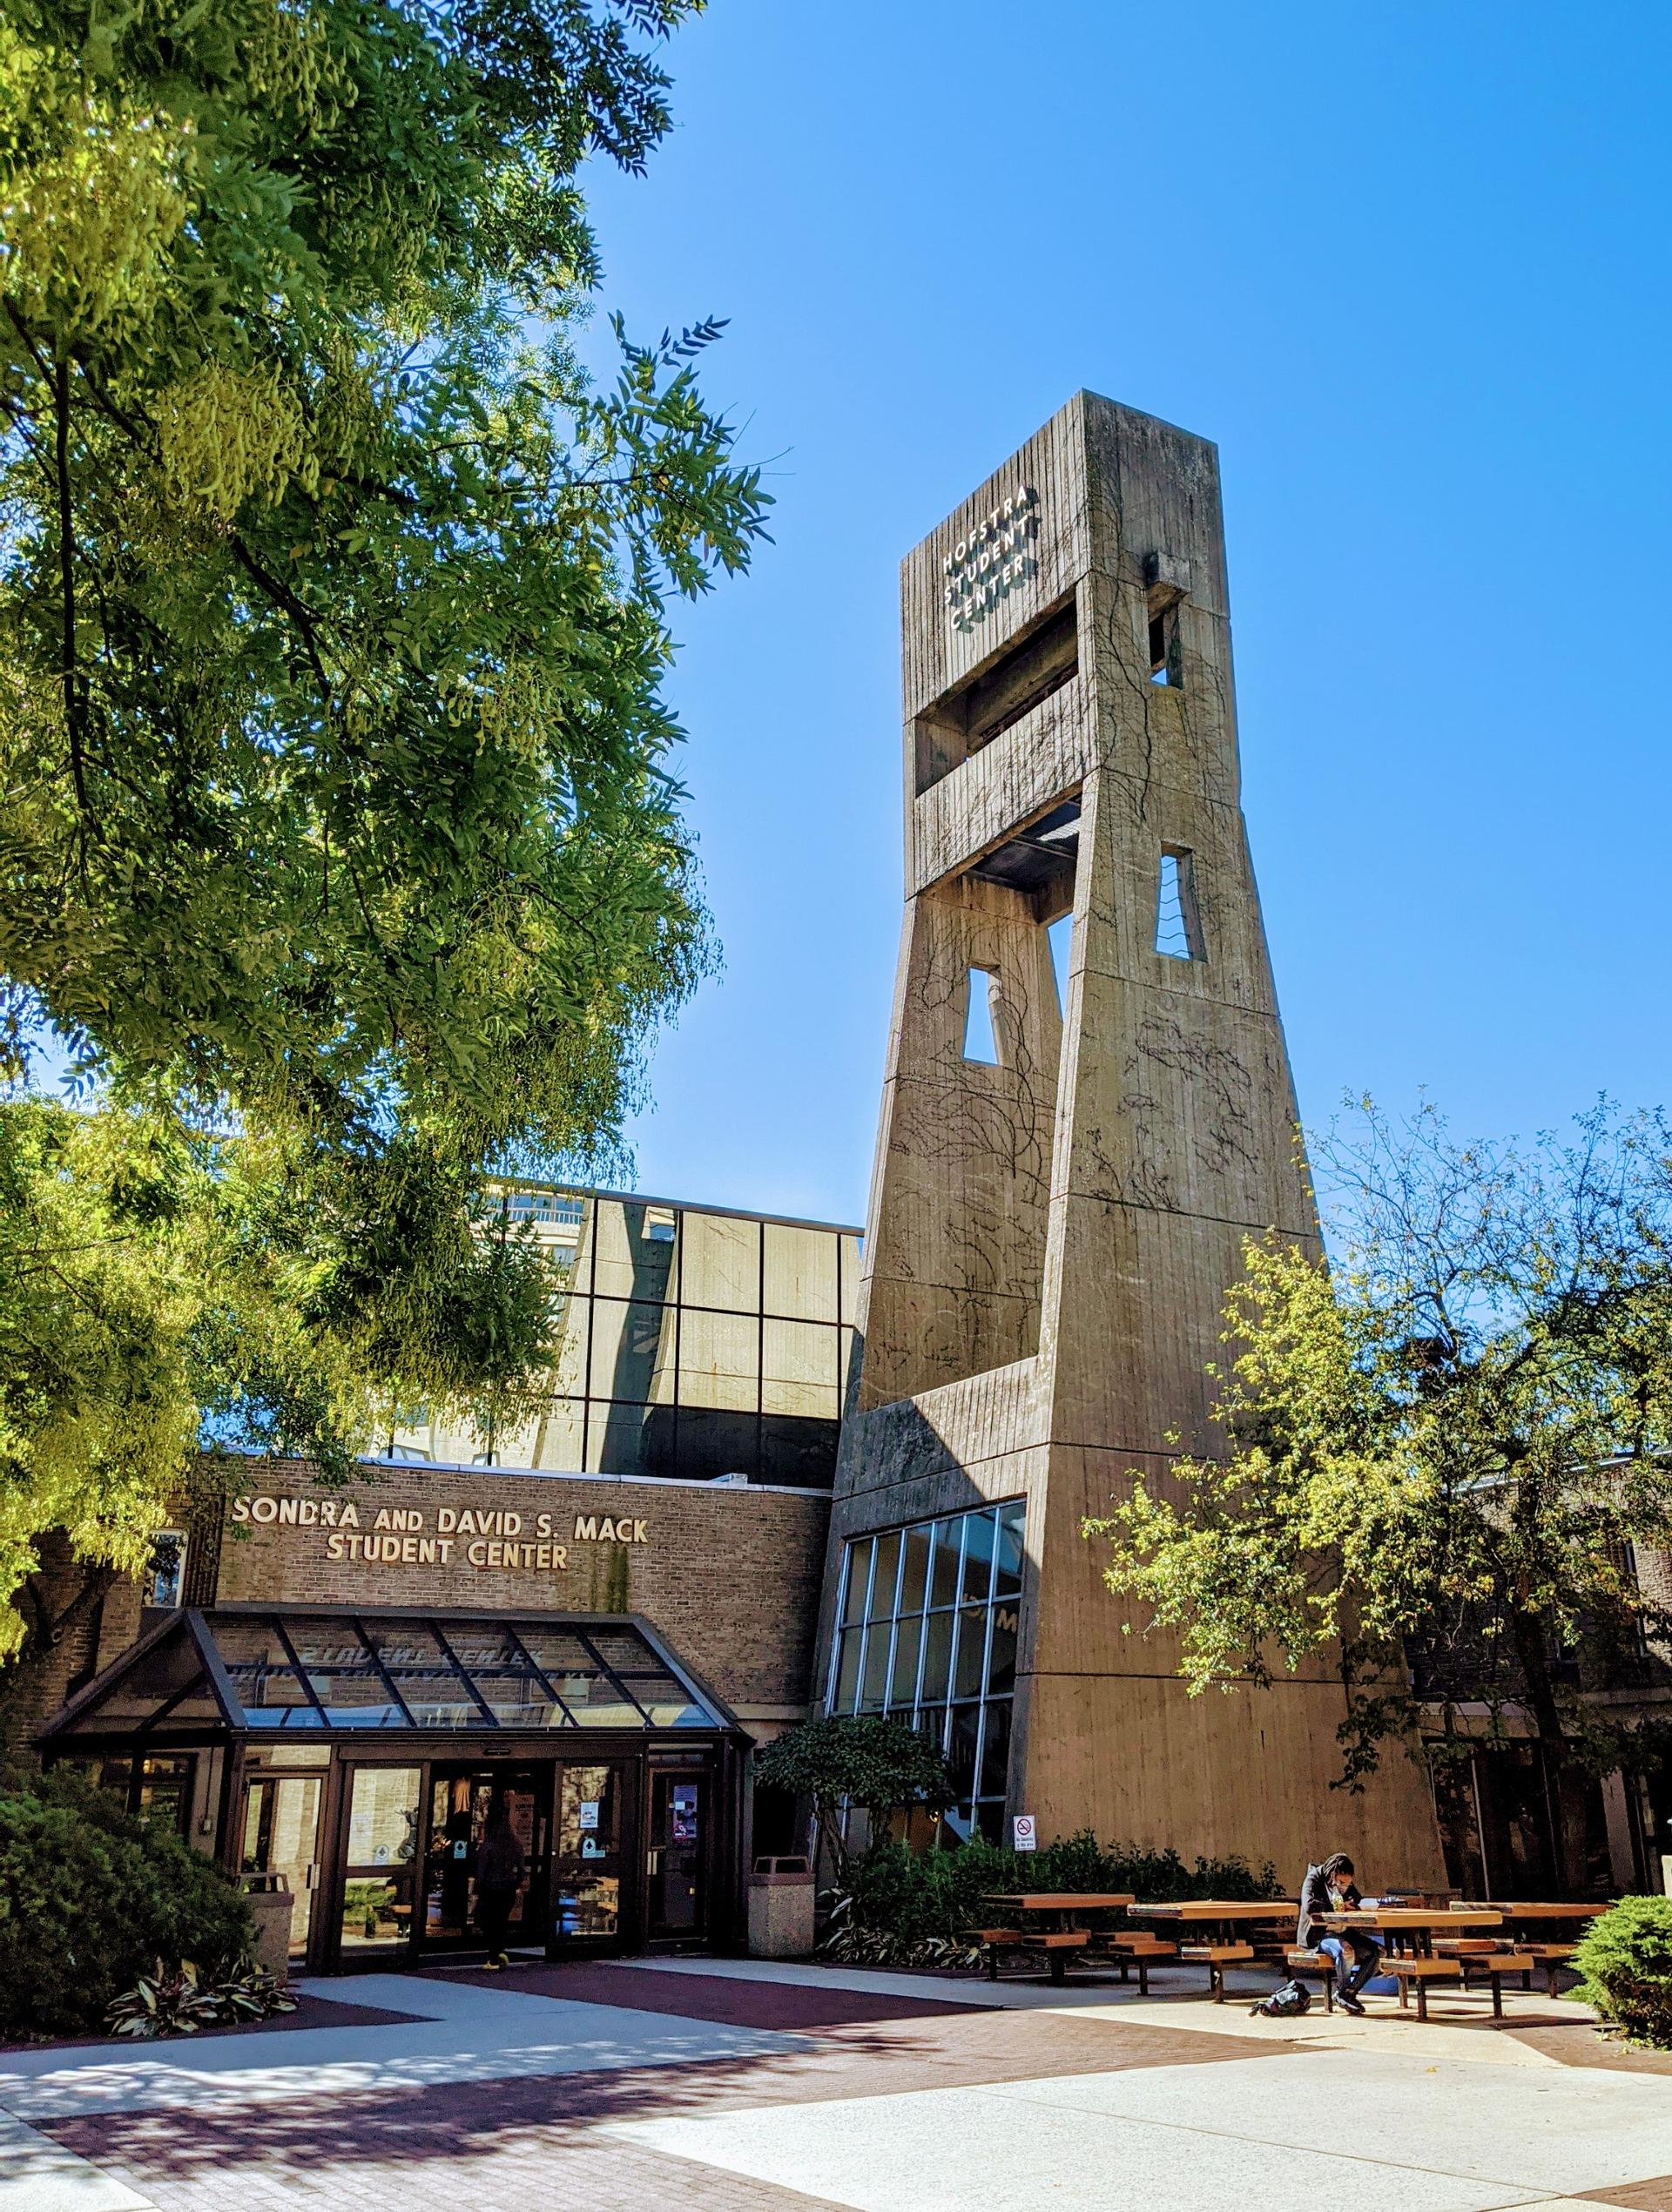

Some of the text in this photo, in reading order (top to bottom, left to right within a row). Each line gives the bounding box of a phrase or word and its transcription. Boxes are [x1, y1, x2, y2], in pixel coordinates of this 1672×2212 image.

[942, 485, 1028, 575] HOFSTRA
[944, 515, 1028, 604] STUDENT
[951, 555, 1023, 630] CENTER
[232, 1496, 649, 1543] SONDRA AND DAVID S. MACK
[327, 1534, 567, 1569] STUDENT CENTER
